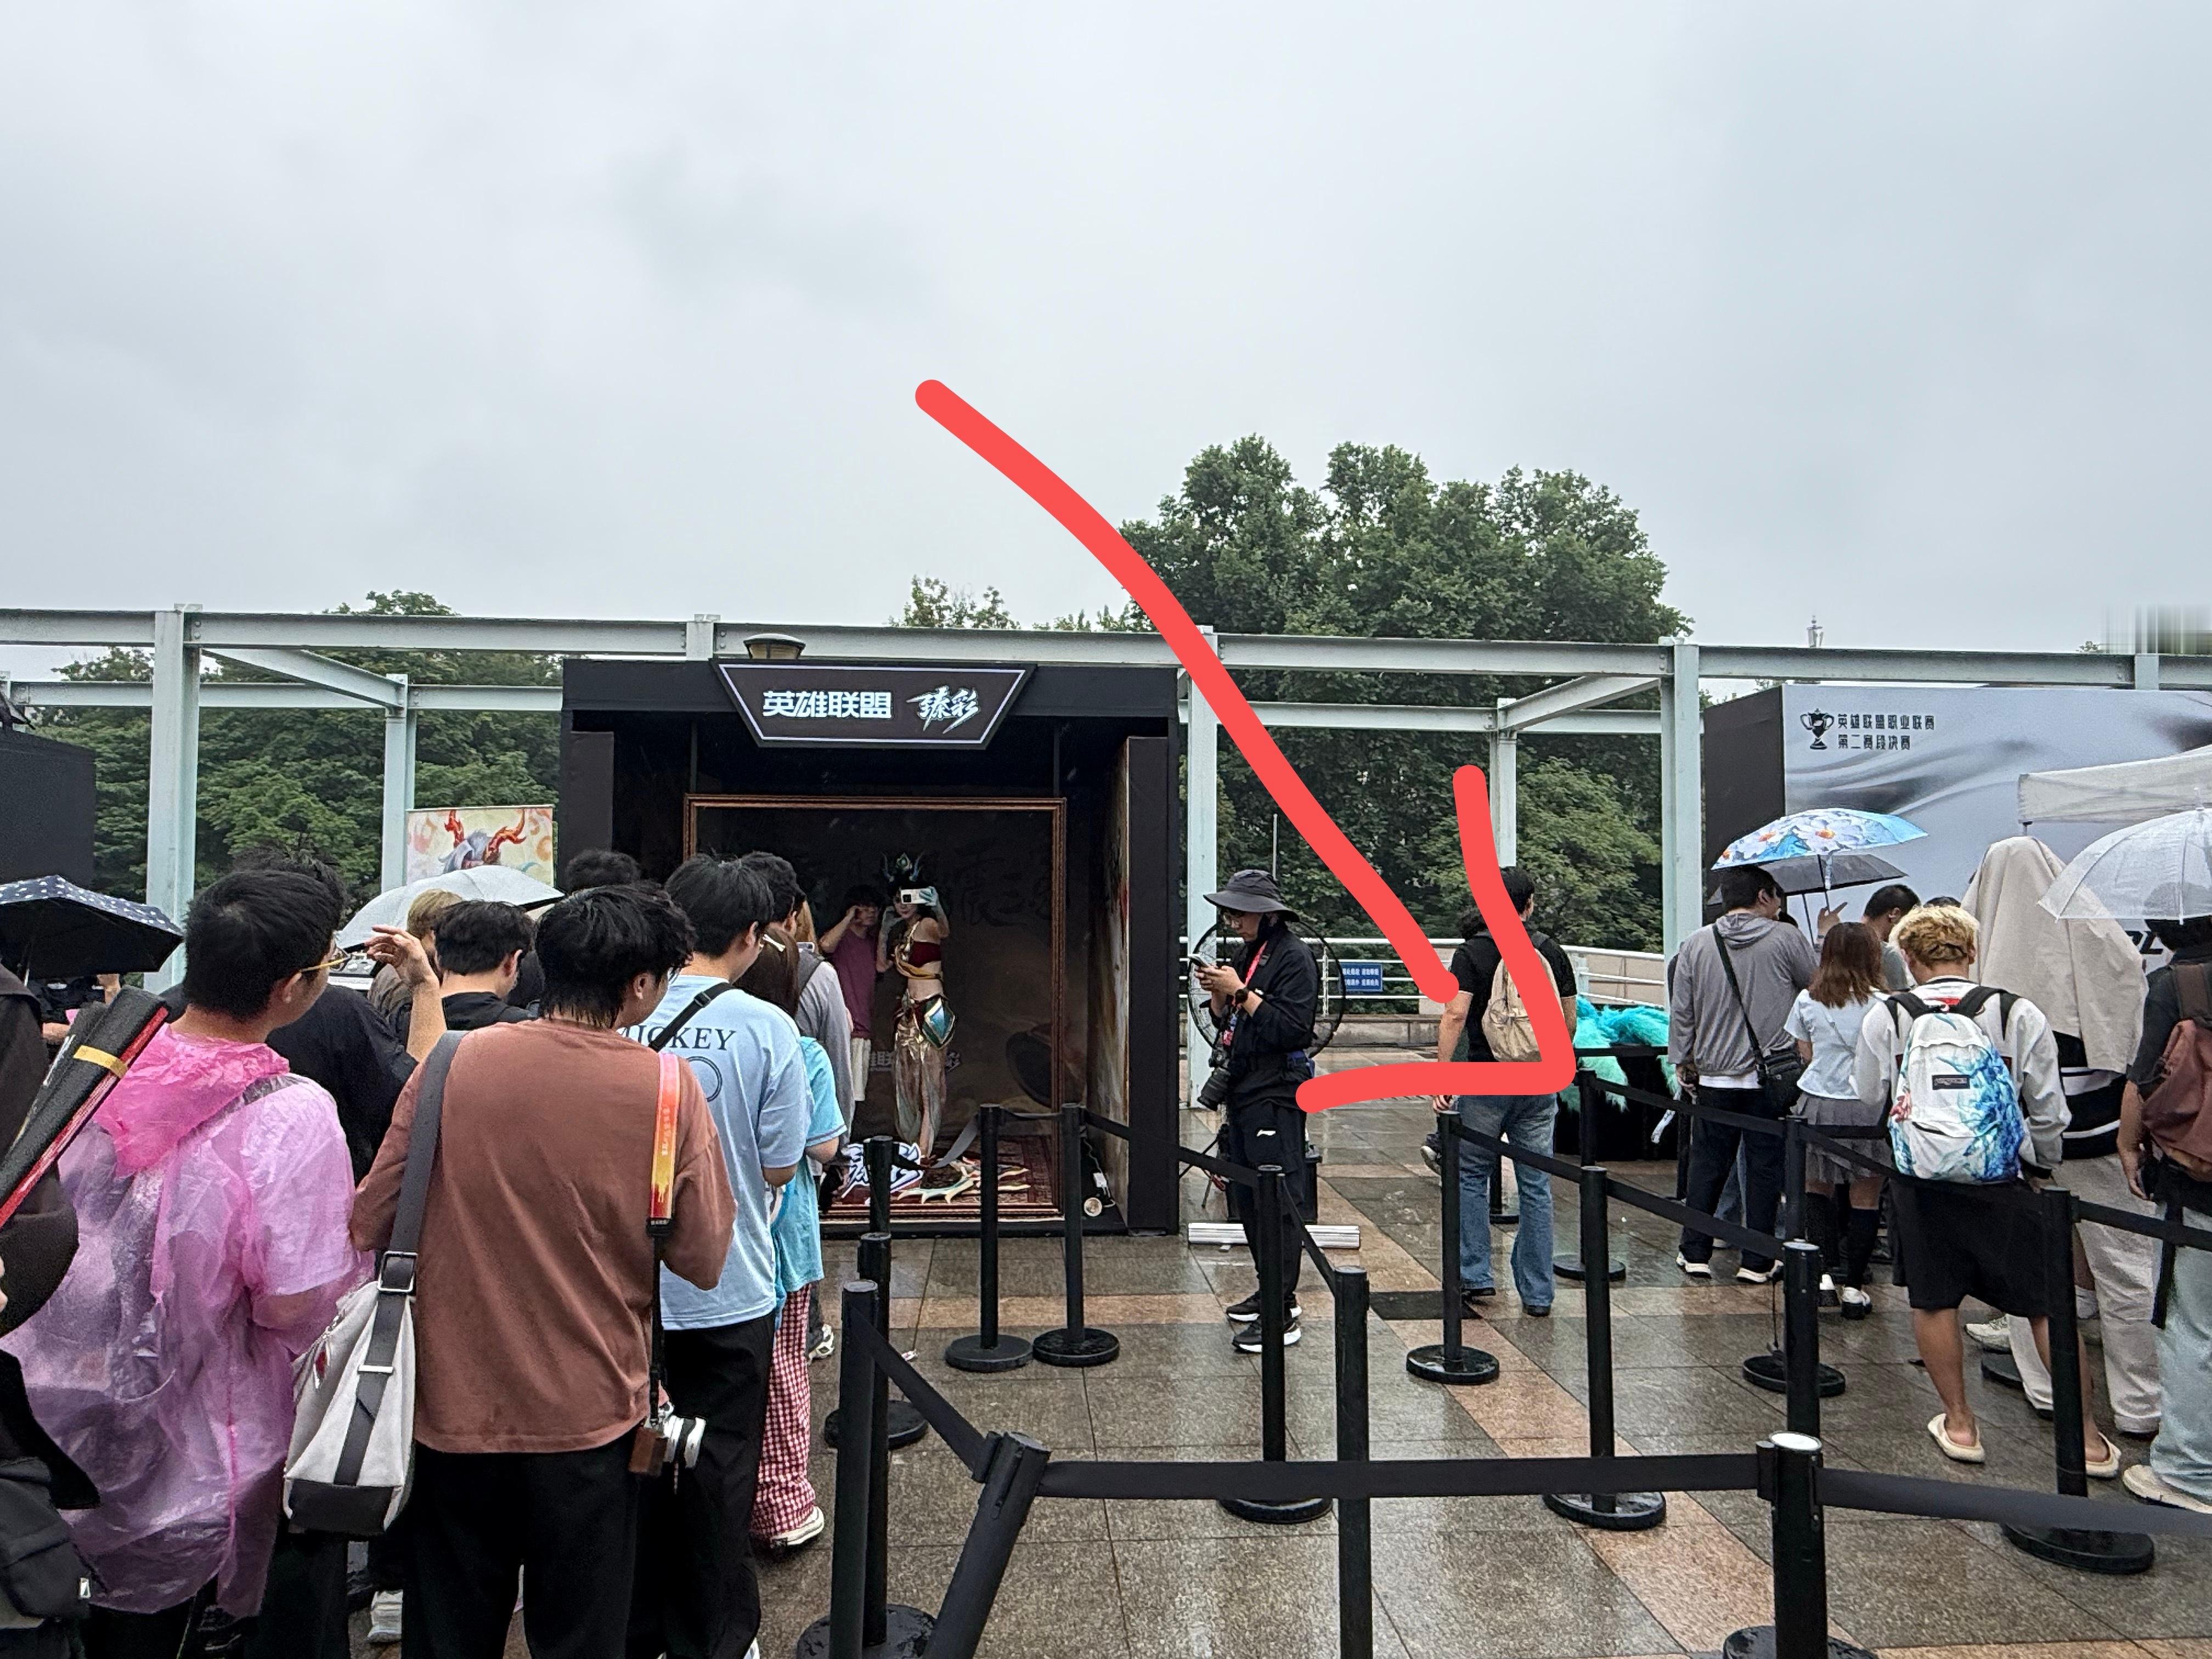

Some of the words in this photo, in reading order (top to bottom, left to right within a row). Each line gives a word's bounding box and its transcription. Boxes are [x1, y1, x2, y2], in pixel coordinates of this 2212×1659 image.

[763, 691, 892, 718] 英雄联盟
[906, 685, 980, 733] 臻彩
[1838, 713, 1934, 730] 英雄联盟职业联赛
[1838, 734, 1910, 750] 第二赛段决赛
